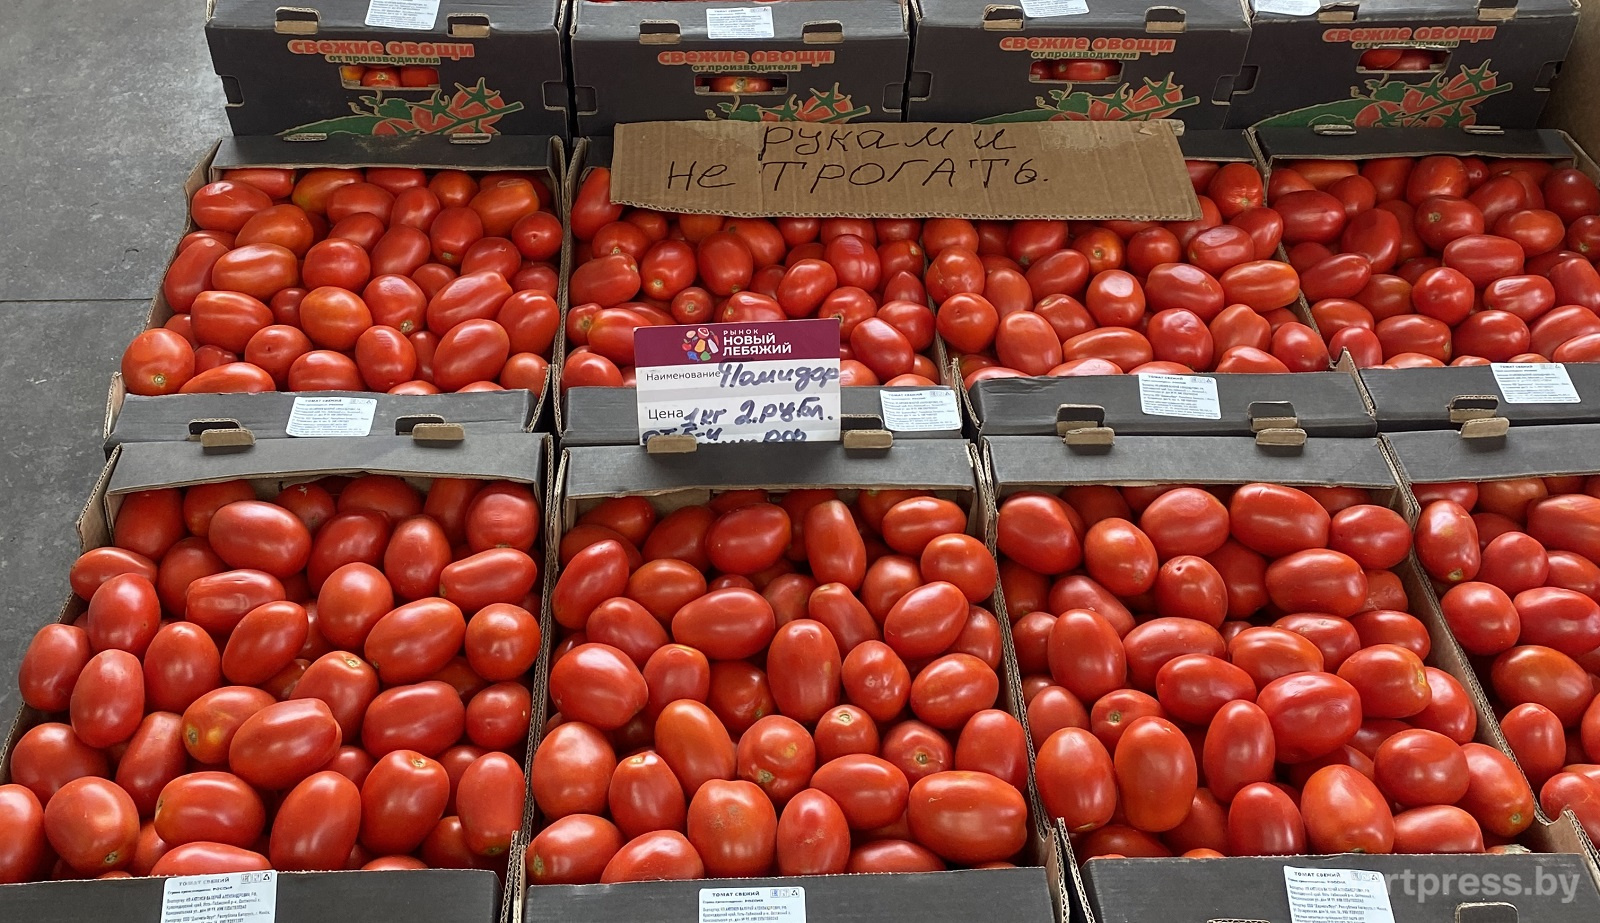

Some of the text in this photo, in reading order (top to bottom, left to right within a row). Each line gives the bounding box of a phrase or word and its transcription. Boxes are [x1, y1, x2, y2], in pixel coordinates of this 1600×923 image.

[328, 55, 440, 65] от производителя
[1047, 51, 1138, 60] производителя
[692, 64, 798, 72] от производителя
[723, 332, 776, 346] НОВЫЙ
[722, 342, 792, 356] ЛЕБЯЖИЙ
[646, 370, 721, 381] Наименование
[648, 409, 684, 421] Цена
